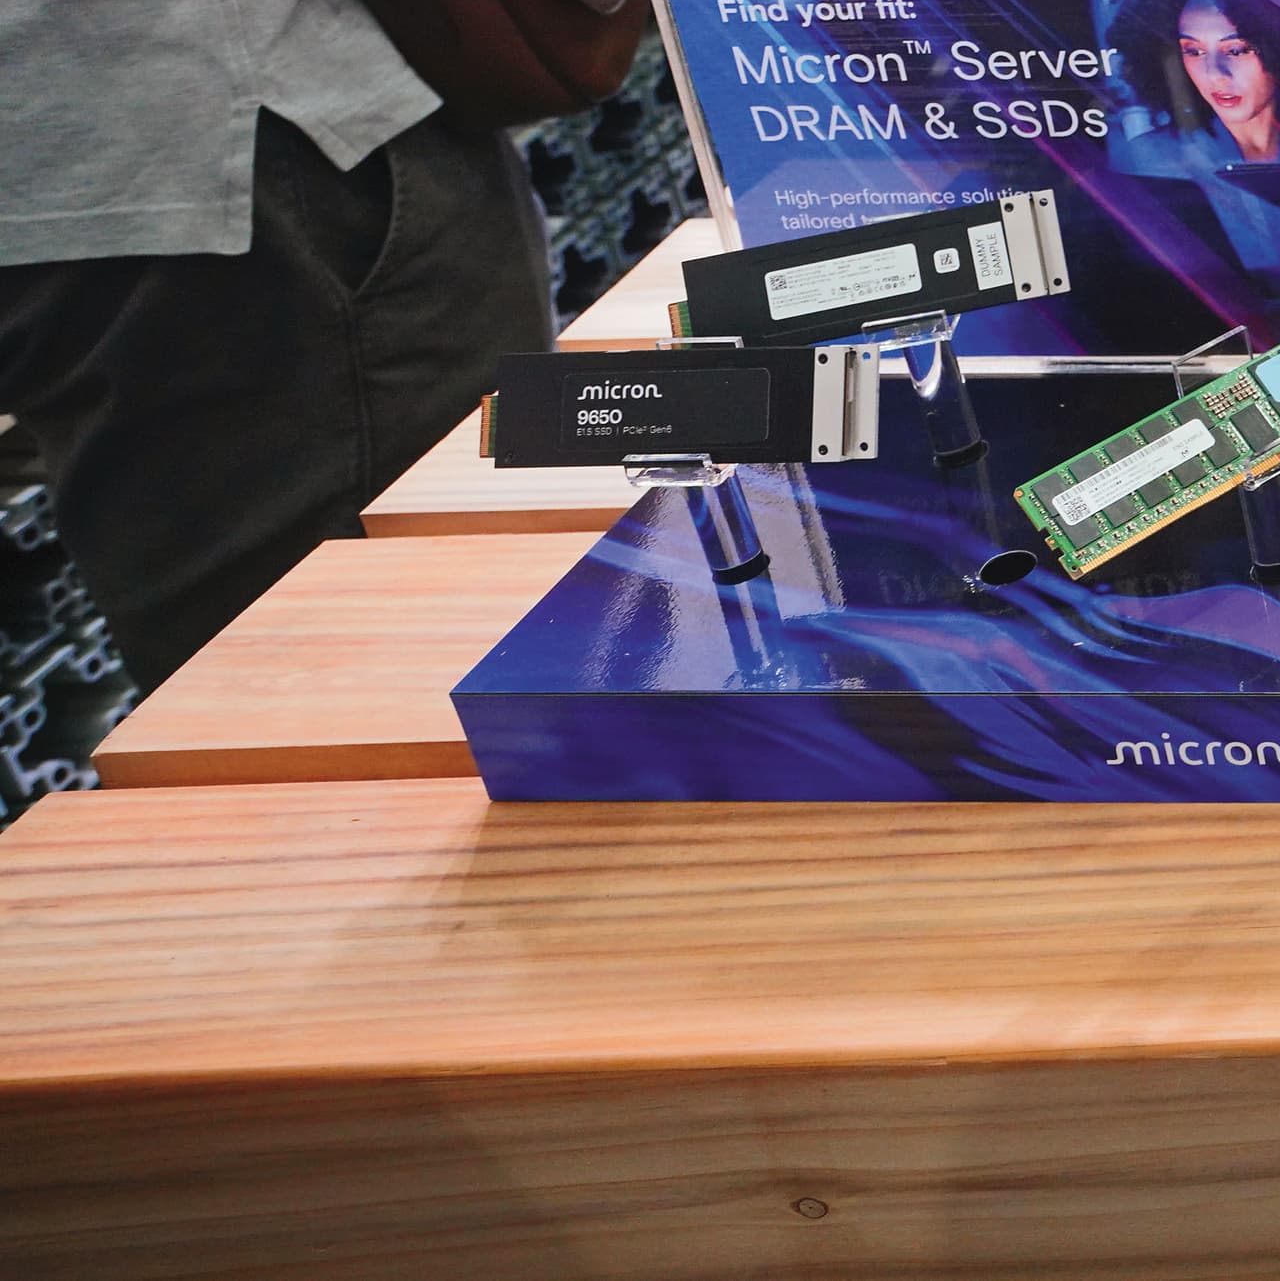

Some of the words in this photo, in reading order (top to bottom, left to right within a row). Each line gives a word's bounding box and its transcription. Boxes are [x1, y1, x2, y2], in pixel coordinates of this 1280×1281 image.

[951, 39, 1118, 81] Server
[749, 103, 907, 143] DRAM
[923, 101, 959, 140] &
[971, 99, 1109, 140] SSDs
[775, 187, 955, 209] High-performance
[781, 213, 857, 230] tailored
[974, 237, 991, 279] DUMMY
[988, 233, 1003, 278] SAMPLE
[577, 380, 663, 400] micron
[577, 409, 623, 425] 9650
[594, 427, 612, 436] SSD
